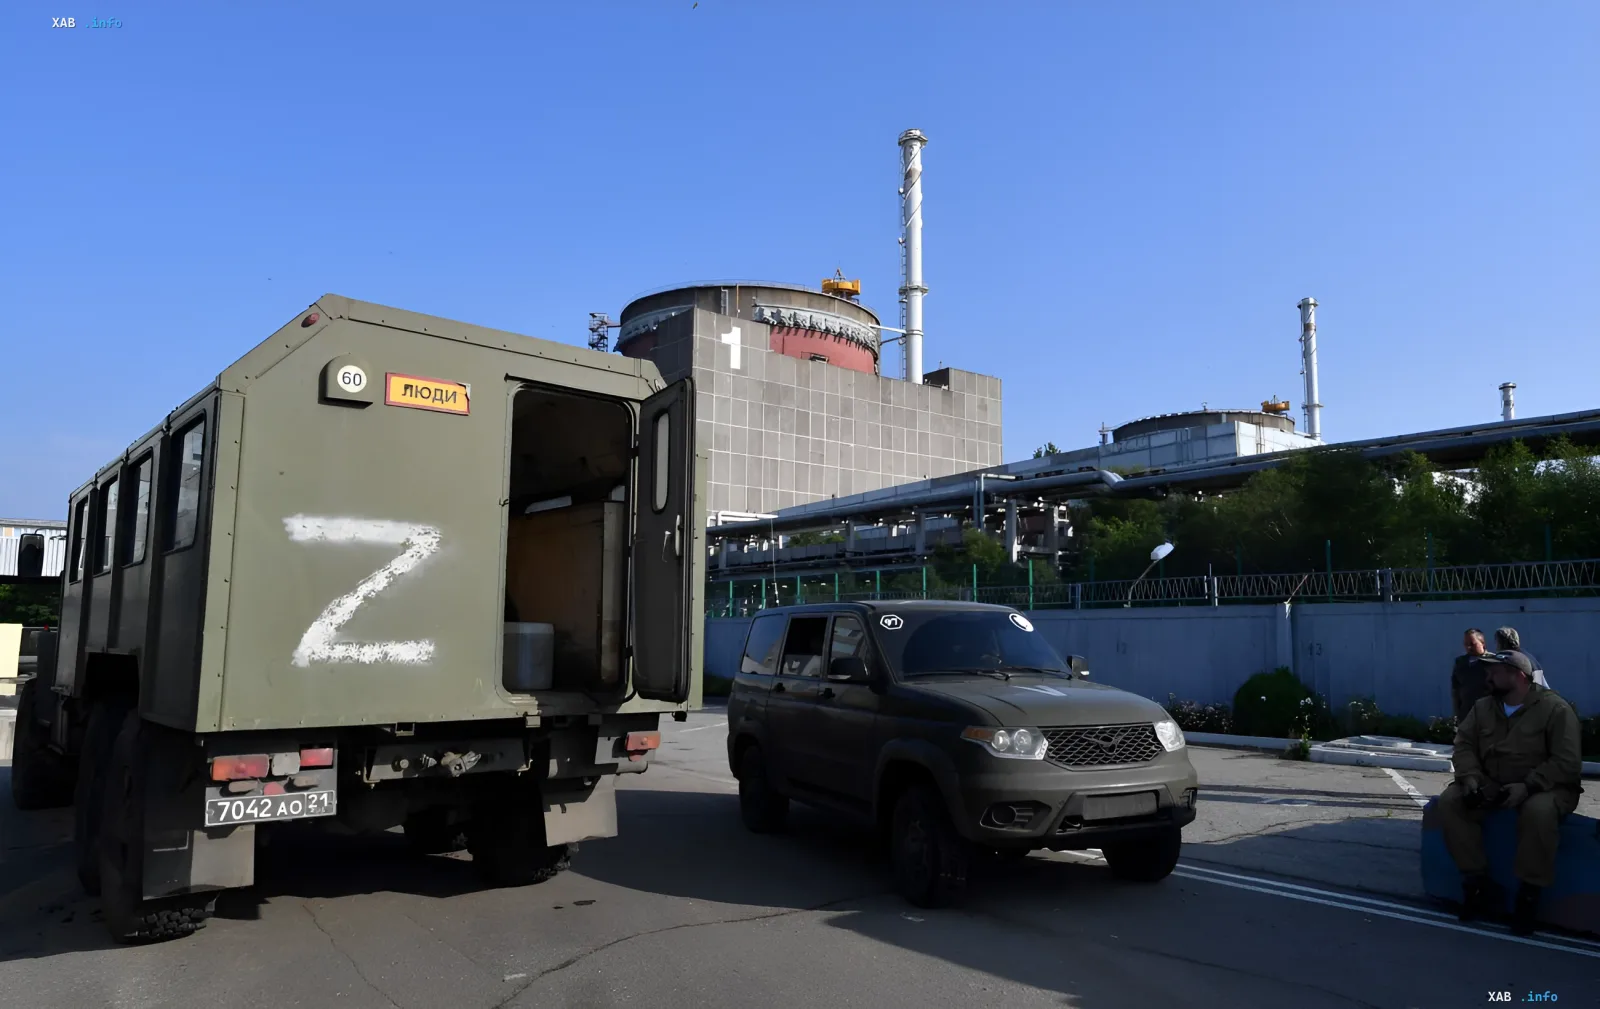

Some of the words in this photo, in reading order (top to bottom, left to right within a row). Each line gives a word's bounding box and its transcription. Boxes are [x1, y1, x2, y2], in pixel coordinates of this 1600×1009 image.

[721, 326, 741, 370] 1
[341, 371, 362, 387] 60
[401, 383, 457, 405] ЛЮДИ
[282, 513, 443, 668] Z
[217, 798, 272, 822] 7042
[307, 792, 329, 809] 21
